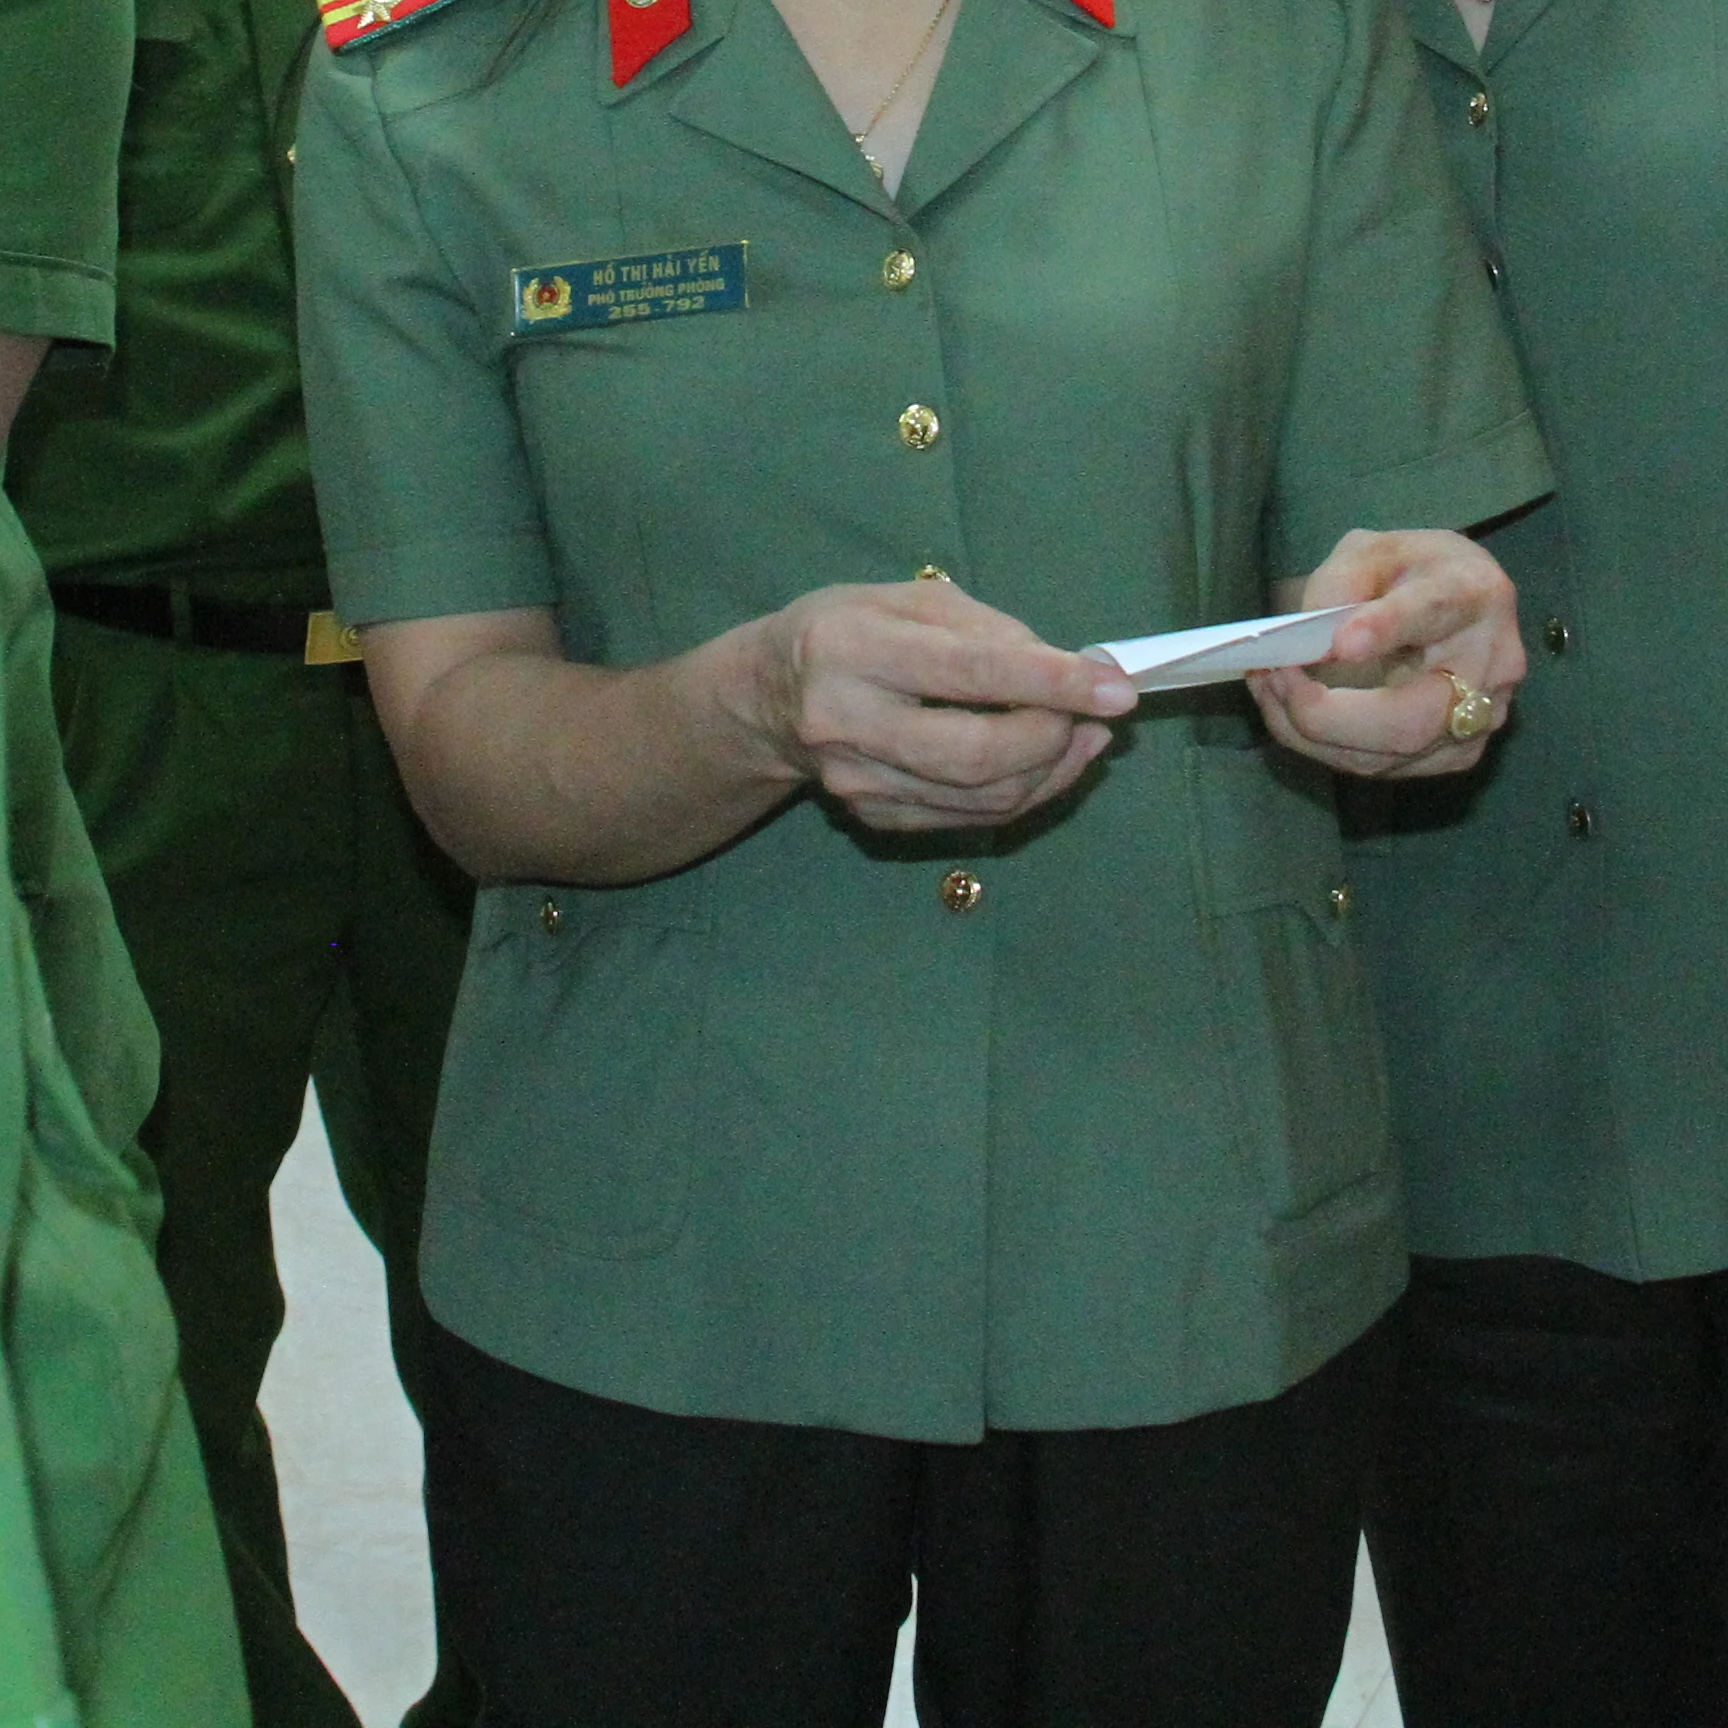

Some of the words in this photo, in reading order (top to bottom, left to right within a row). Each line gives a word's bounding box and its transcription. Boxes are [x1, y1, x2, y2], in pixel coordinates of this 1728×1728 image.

[620, 264, 648, 283] THỊ
[653, 254, 681, 279] HẢI
[588, 288, 616, 306] PHÓ
[619, 281, 674, 302] TRƯỞNG
[678, 277, 725, 294] PHÒNG
